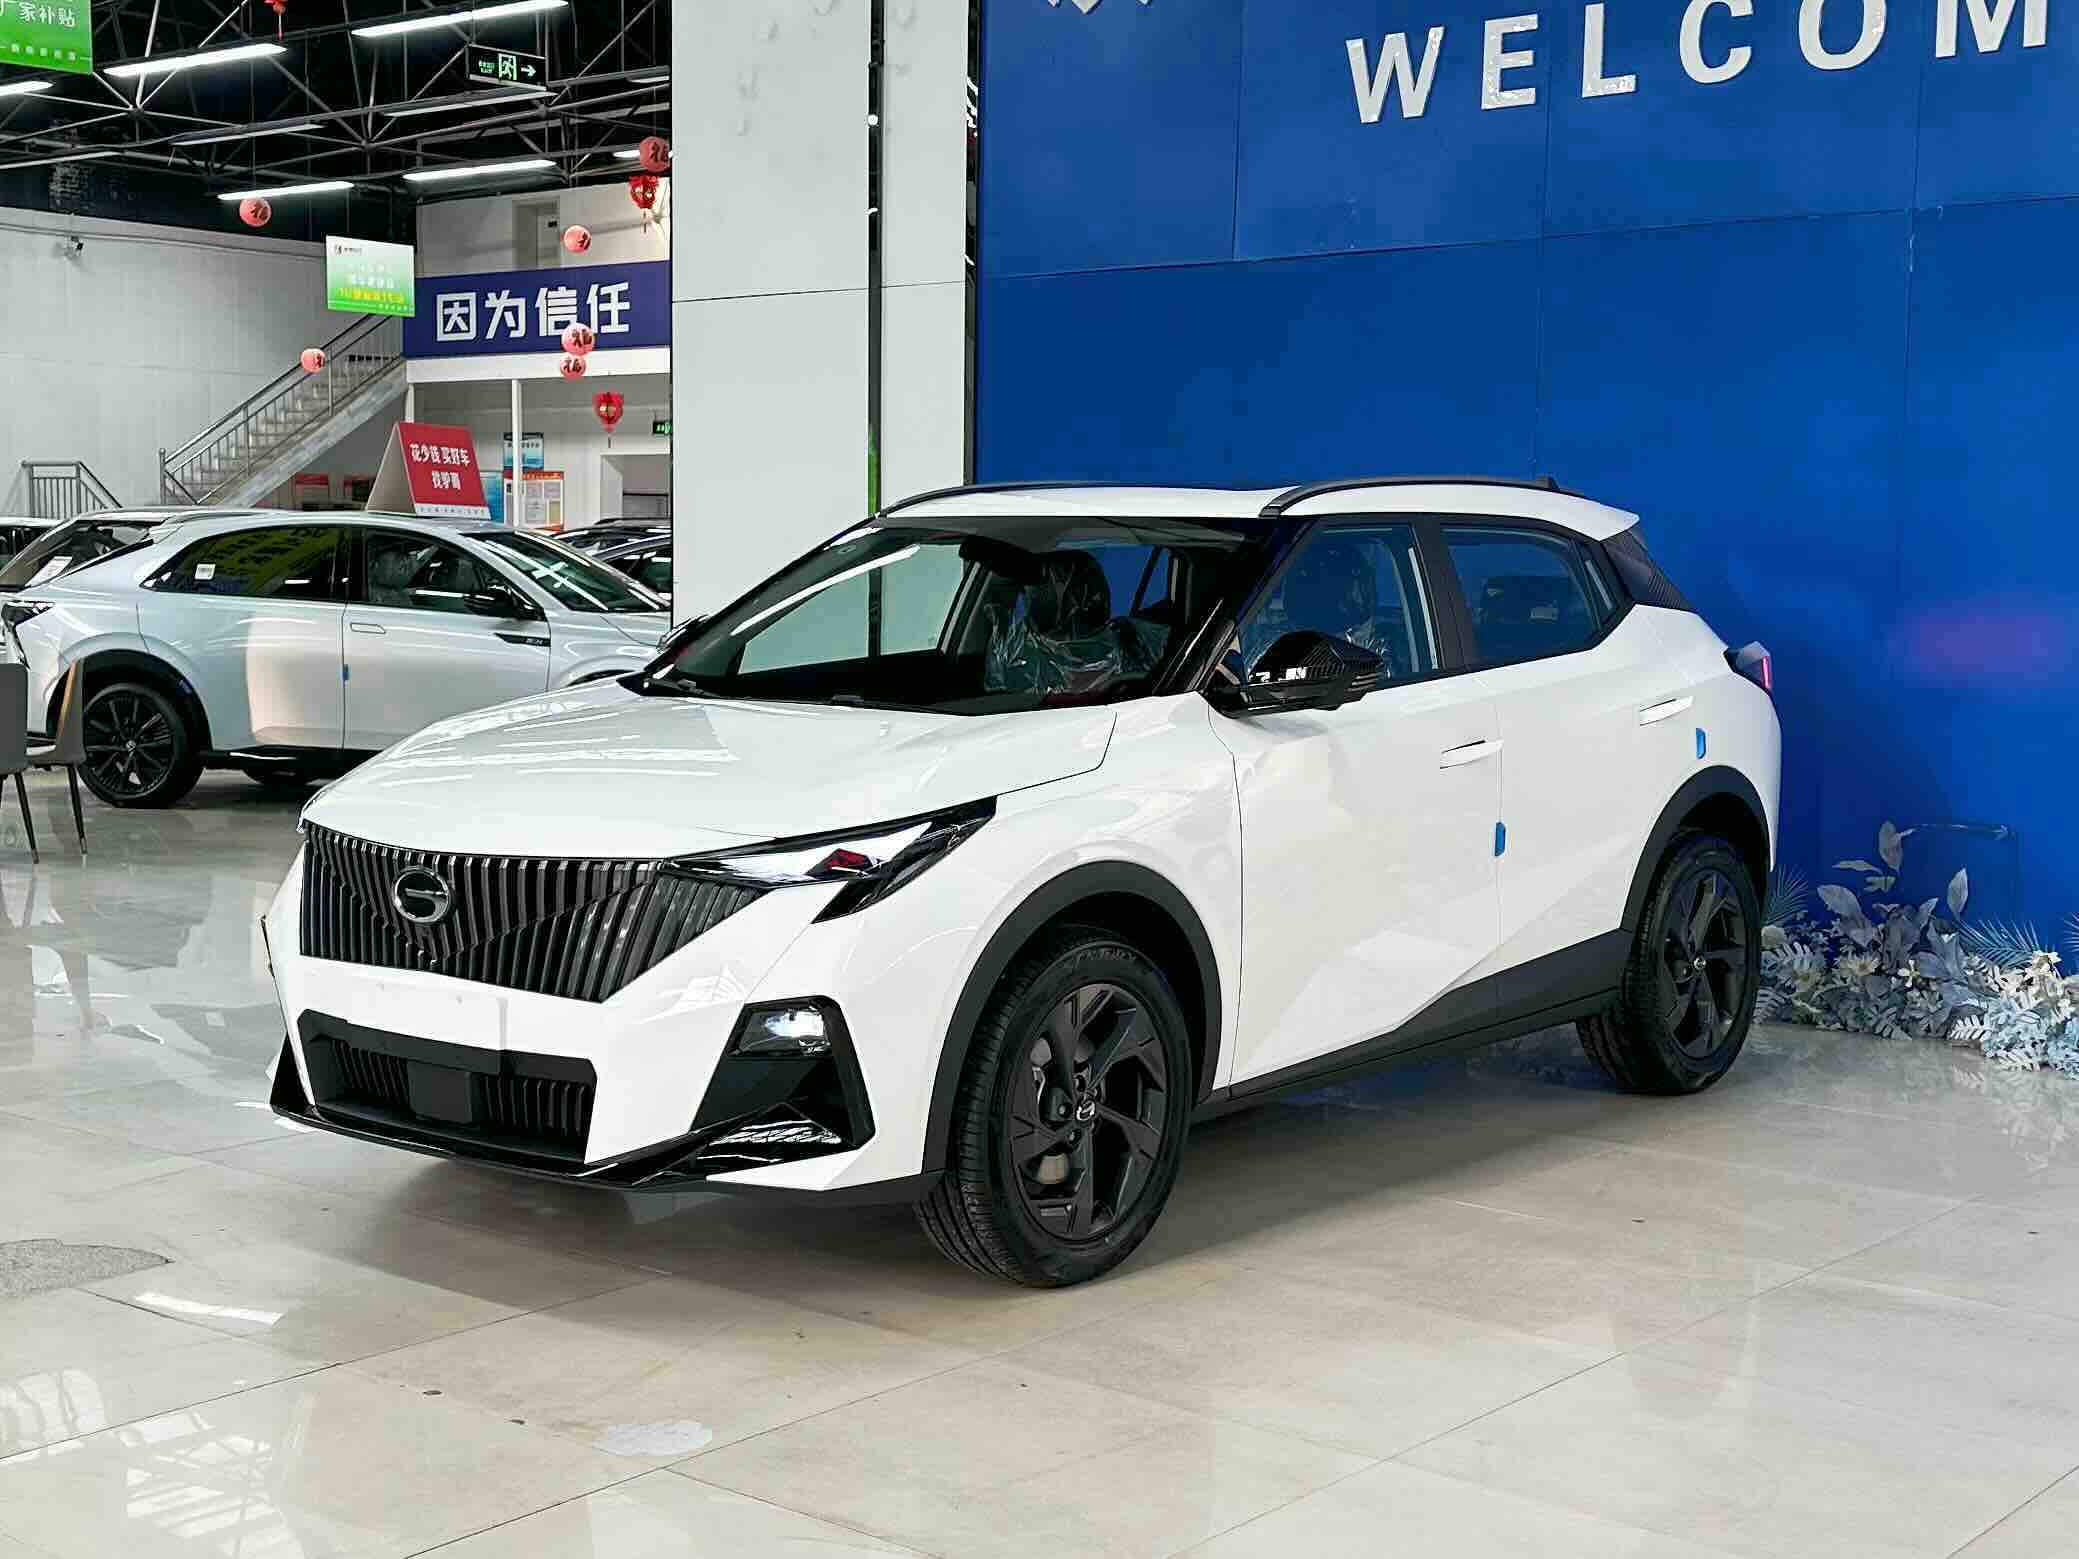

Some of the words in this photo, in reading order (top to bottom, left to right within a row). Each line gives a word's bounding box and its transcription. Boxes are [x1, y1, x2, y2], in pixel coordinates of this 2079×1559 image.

[1345, 0, 2047, 124] WELCOM
[436, 282, 631, 342] 因为信任
